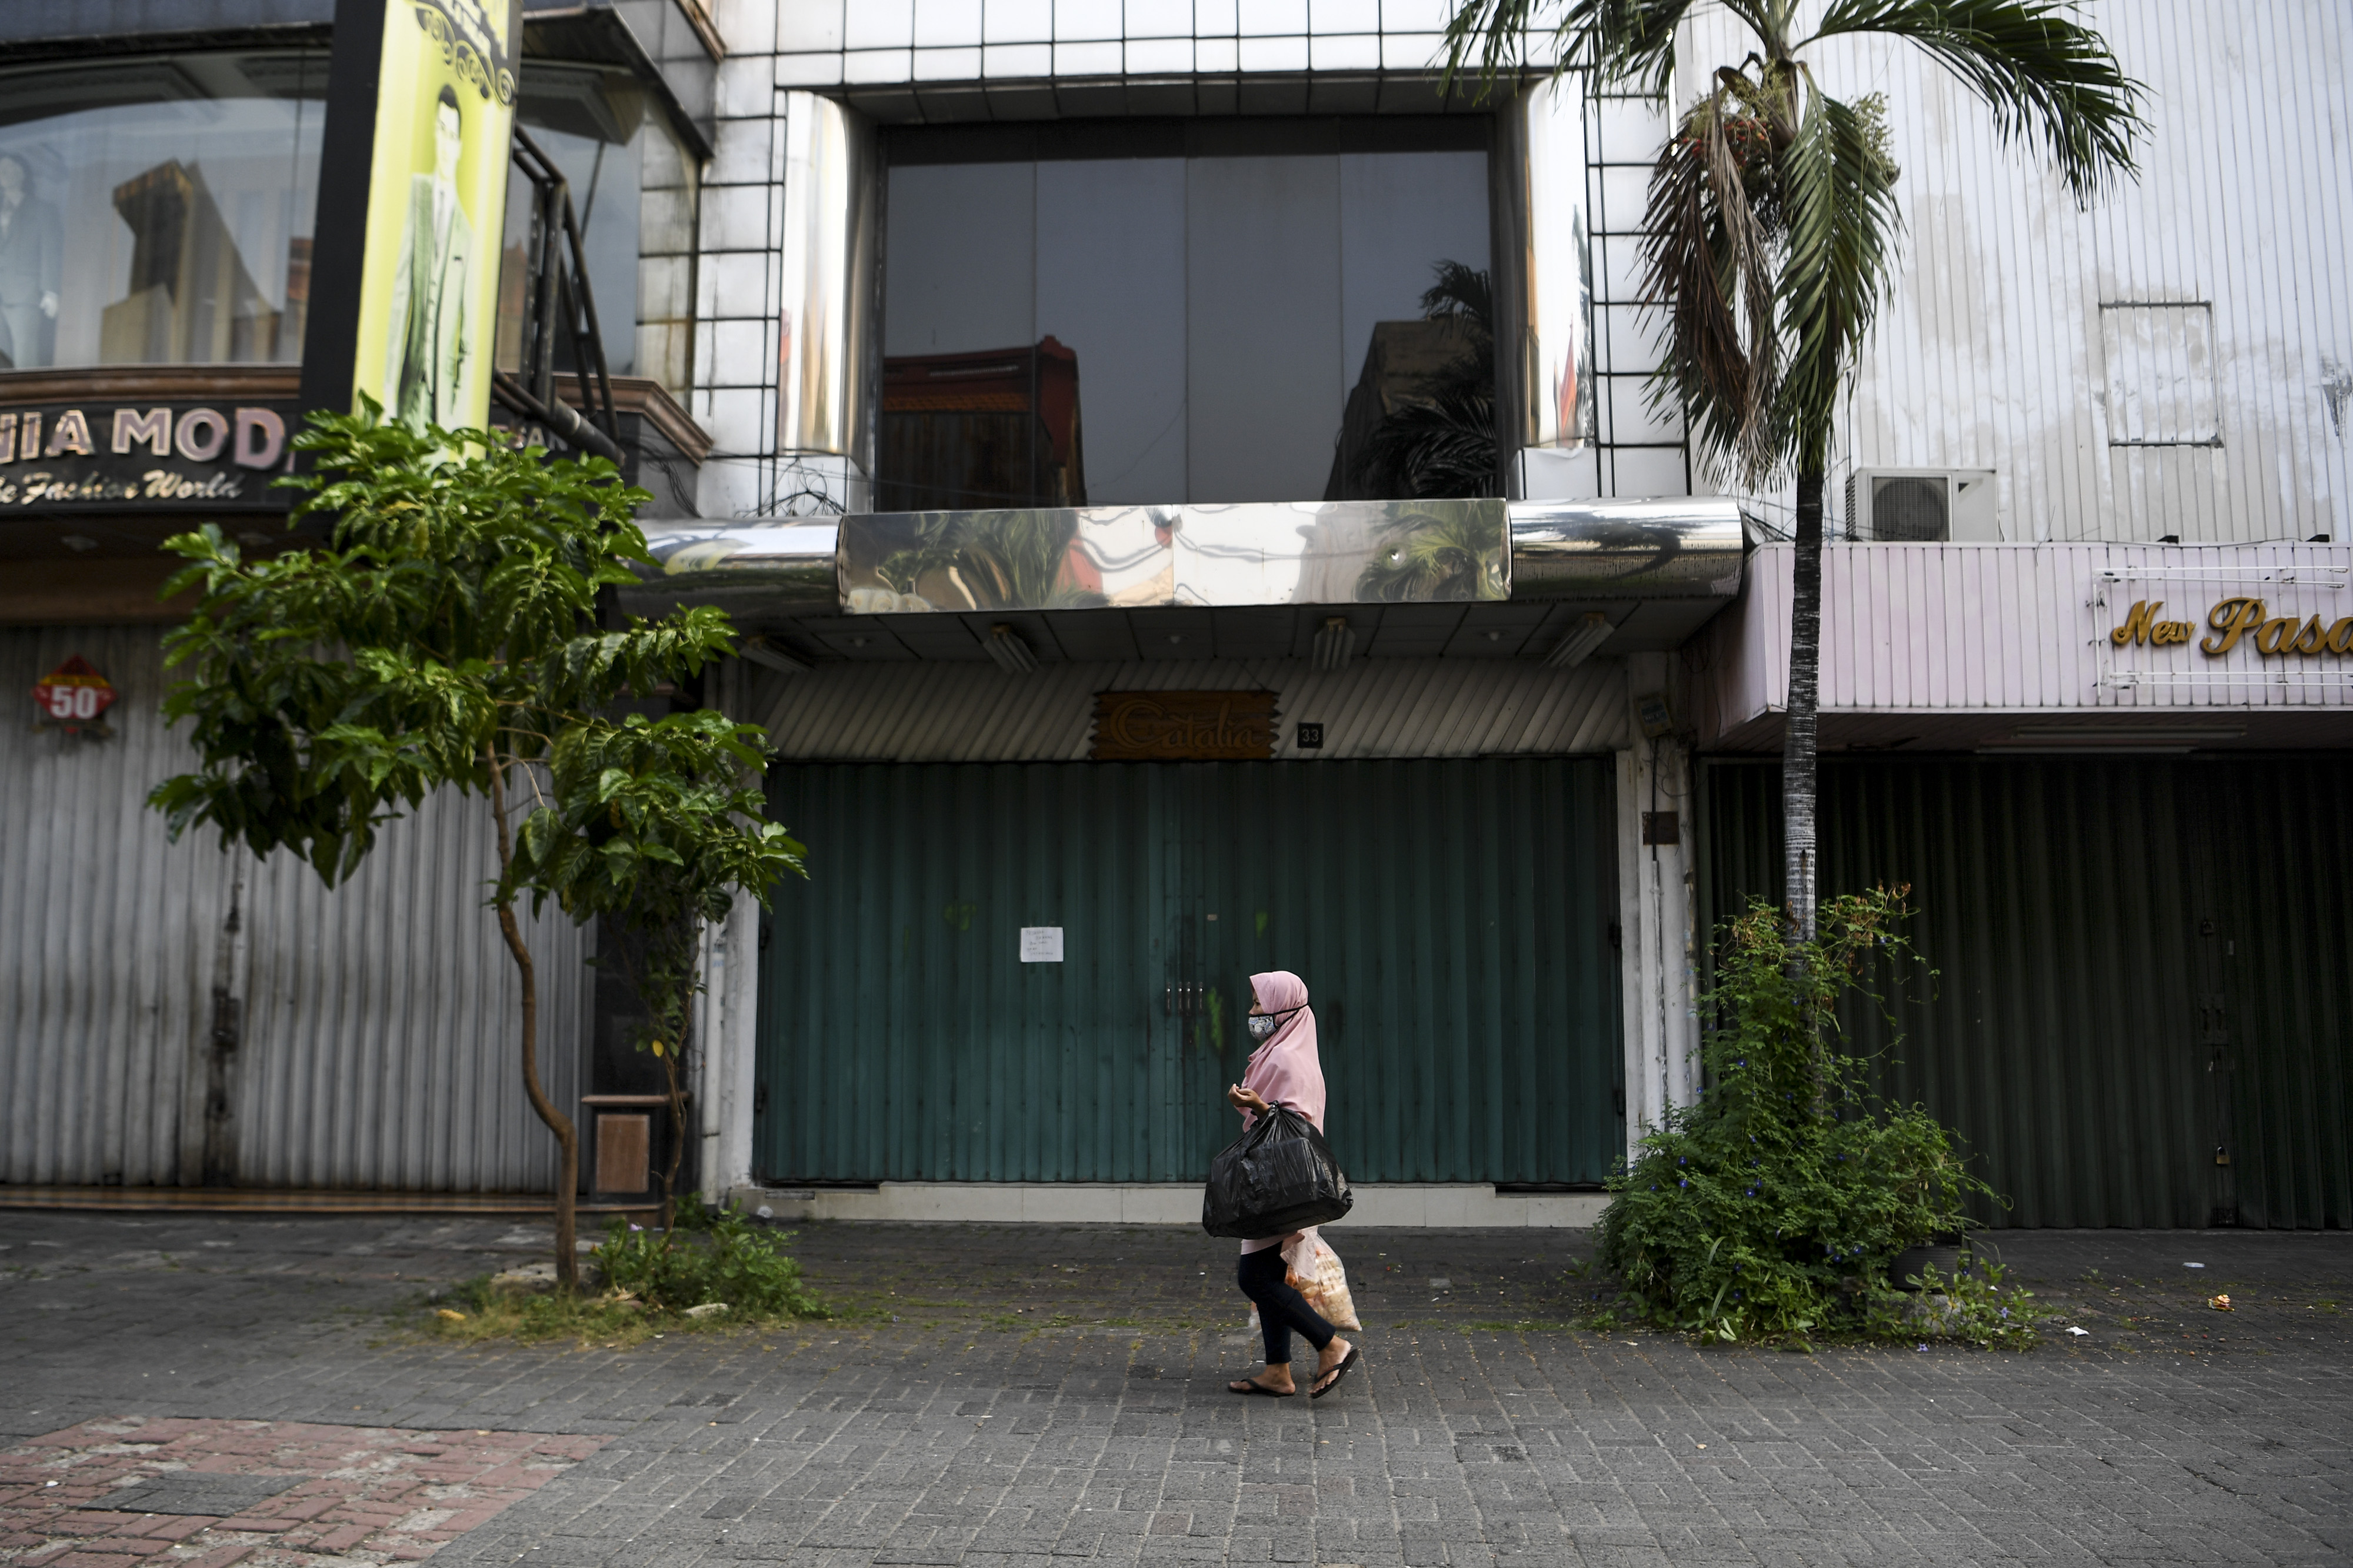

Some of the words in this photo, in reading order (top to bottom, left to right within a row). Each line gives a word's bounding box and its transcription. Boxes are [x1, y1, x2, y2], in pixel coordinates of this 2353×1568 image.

[111, 407, 294, 473] MOD
[143, 469, 244, 499] World
[2110, 600, 2197, 646] New
[51, 686, 98, 719] 50
[1109, 698, 1268, 750] Catalia
[1302, 729, 1319, 742] 33
